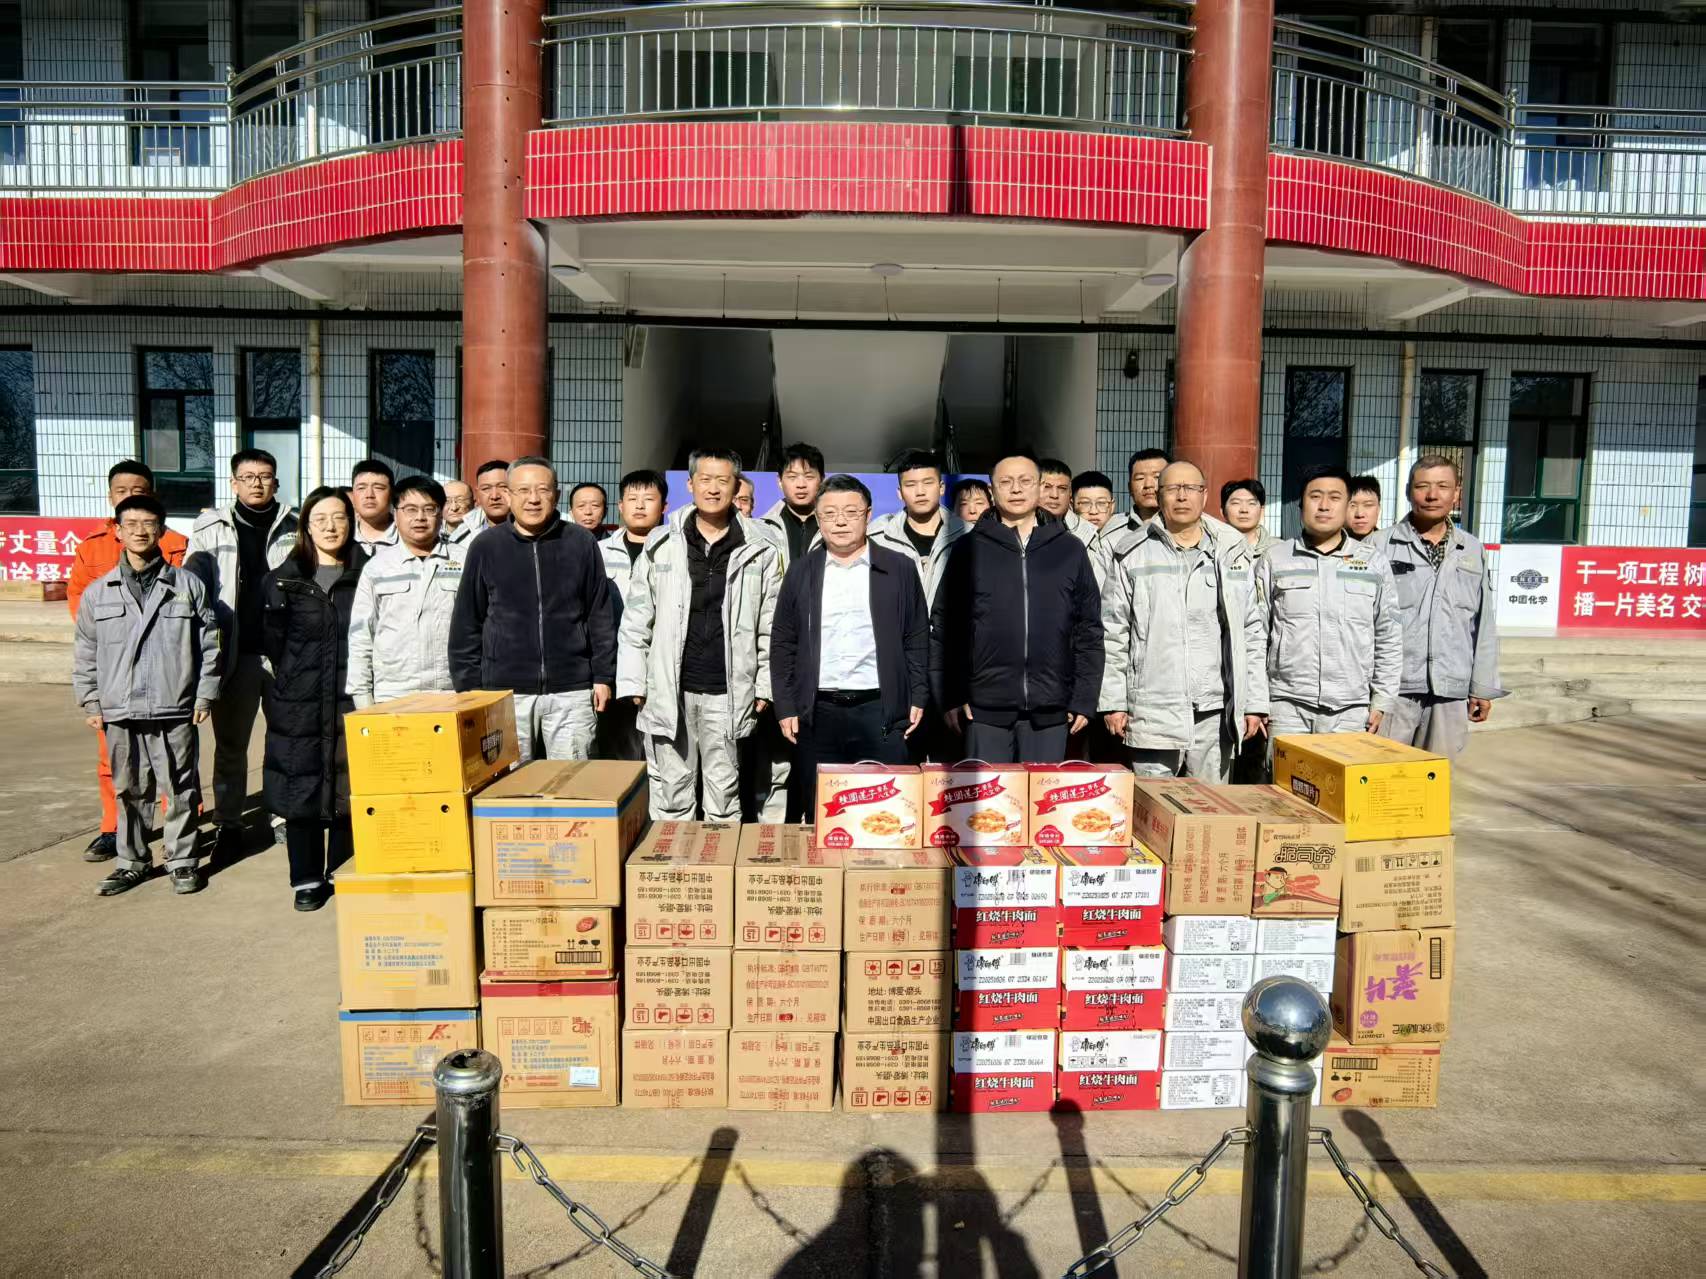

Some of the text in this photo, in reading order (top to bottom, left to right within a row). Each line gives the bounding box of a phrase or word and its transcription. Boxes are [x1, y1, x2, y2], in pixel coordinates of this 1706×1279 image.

[1576, 561, 1679, 586] 干一项工程
[1508, 594, 1548, 605] 中国化学
[1574, 592, 1675, 618] 播一片美名
[639, 872, 712, 883] 中国出口食品生产企业
[749, 875, 822, 885] 中国出口食品生产企业
[976, 910, 1037, 922] 红烧牛肉面
[1082, 908, 1142, 920] 红烧牛肉面
[637, 957, 710, 967] 中国出口食品生产企业
[1364, 962, 1423, 1003] 薯片
[978, 992, 1038, 1004] 红烧牛肉面
[1085, 993, 1143, 1004] 红烧牛肉面
[868, 1016, 943, 1025] 中国出口食品生产企业
[857, 1040, 929, 1051] 中国出口食品生产企业
[975, 1077, 1034, 1088] 红烧牛肉面
[1080, 1074, 1137, 1085] 红烧牛肉面
